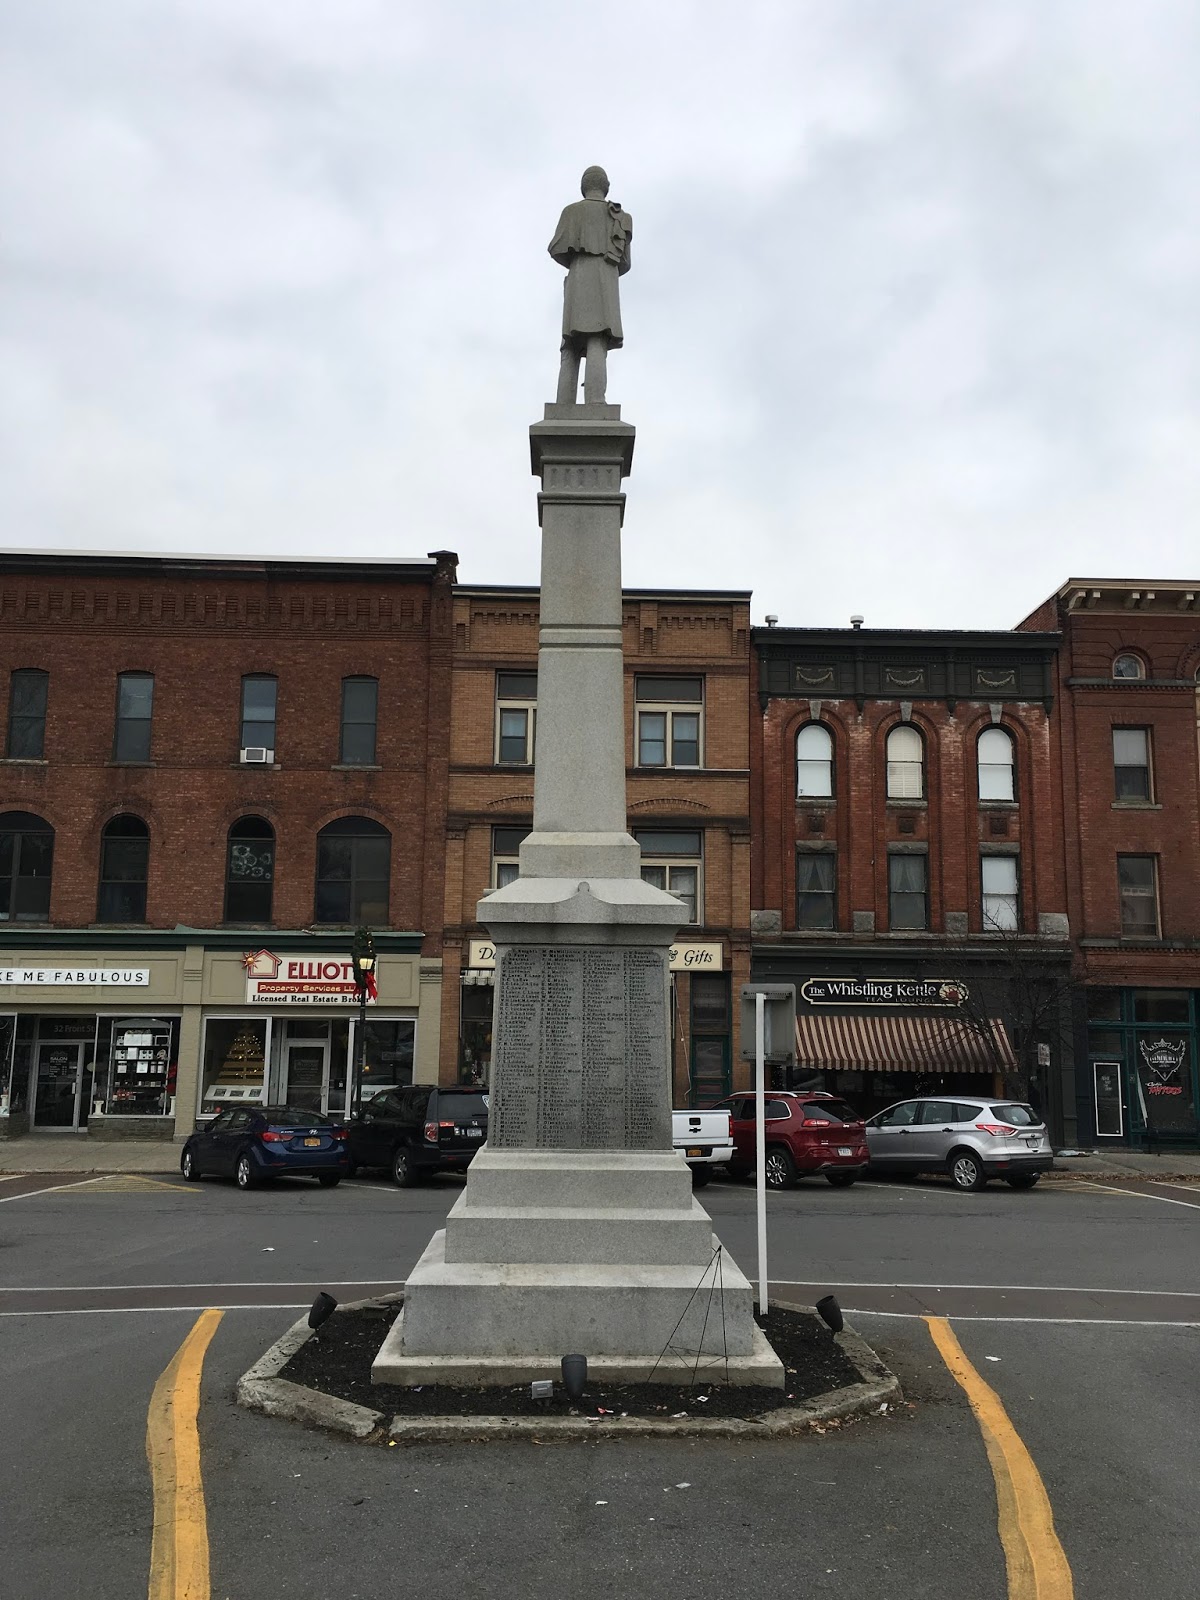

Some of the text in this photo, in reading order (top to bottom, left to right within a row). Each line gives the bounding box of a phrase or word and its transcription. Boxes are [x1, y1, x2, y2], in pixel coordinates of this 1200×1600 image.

[684, 949, 714, 966] Gifts
[287, 962, 354, 980] ELLIOT
[23, 972, 45, 982] ME
[55, 972, 143, 982] FABULOUS
[259, 984, 300, 993] Property
[303, 984, 341, 992] Services
[809, 983, 937, 998] The Whistling Kettle
[252, 995, 287, 1003] Licensed
[291, 995, 309, 1003] Real
[54, 1025, 63, 1033] 32
[64, 1025, 85, 1033] Front
